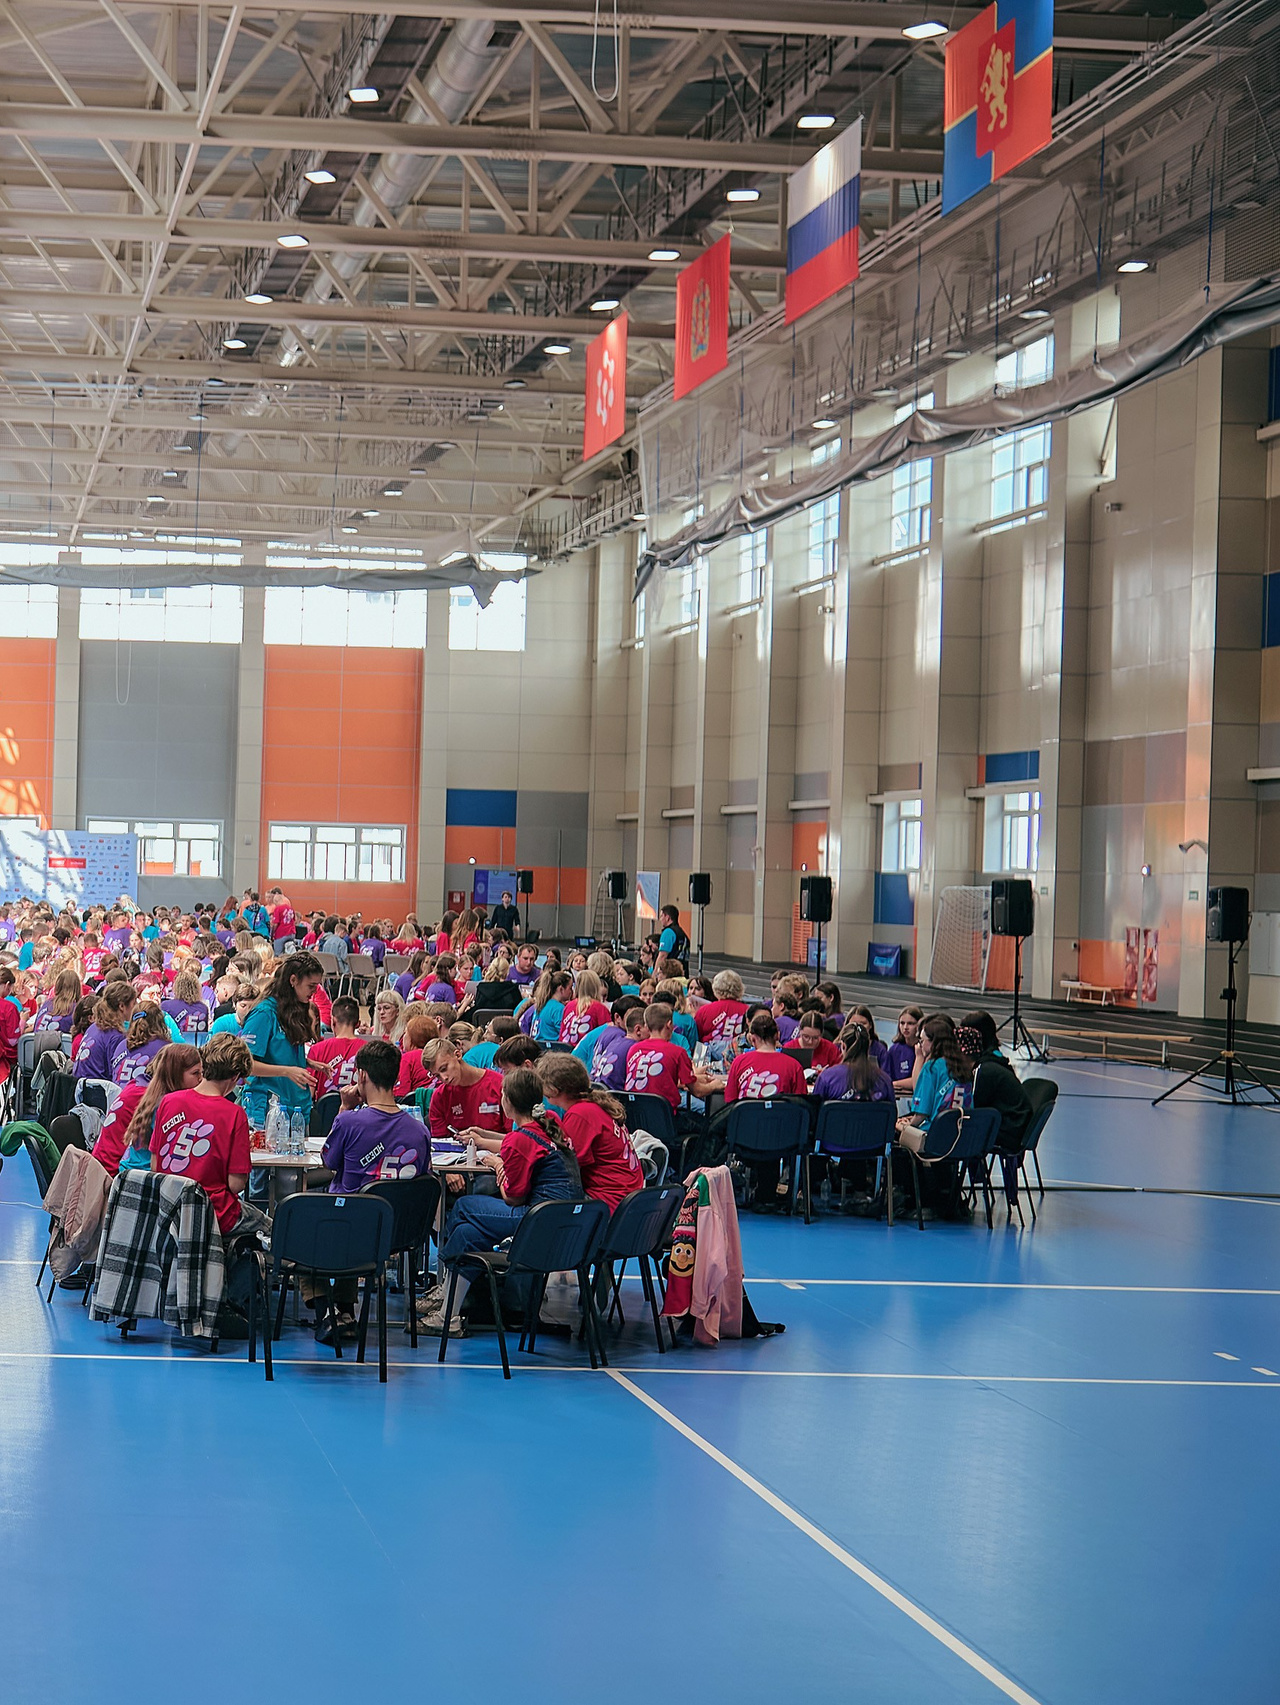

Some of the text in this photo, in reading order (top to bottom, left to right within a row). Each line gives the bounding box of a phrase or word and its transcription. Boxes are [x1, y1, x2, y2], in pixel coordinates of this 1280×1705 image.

[187, 1015, 199, 1032] 5
[722, 1018, 737, 1036] 5
[120, 1059, 137, 1081] 5
[338, 1063, 355, 1085] 5
[637, 1057, 651, 1079] 5
[746, 1075, 765, 1099] 5
[952, 1087, 965, 1109] 5
[162, 1112, 186, 1134] СЕЗОН
[173, 1127, 197, 1157] 5
[359, 1142, 385, 1168] СЕЗОН
[380, 1156, 400, 1181] 5
